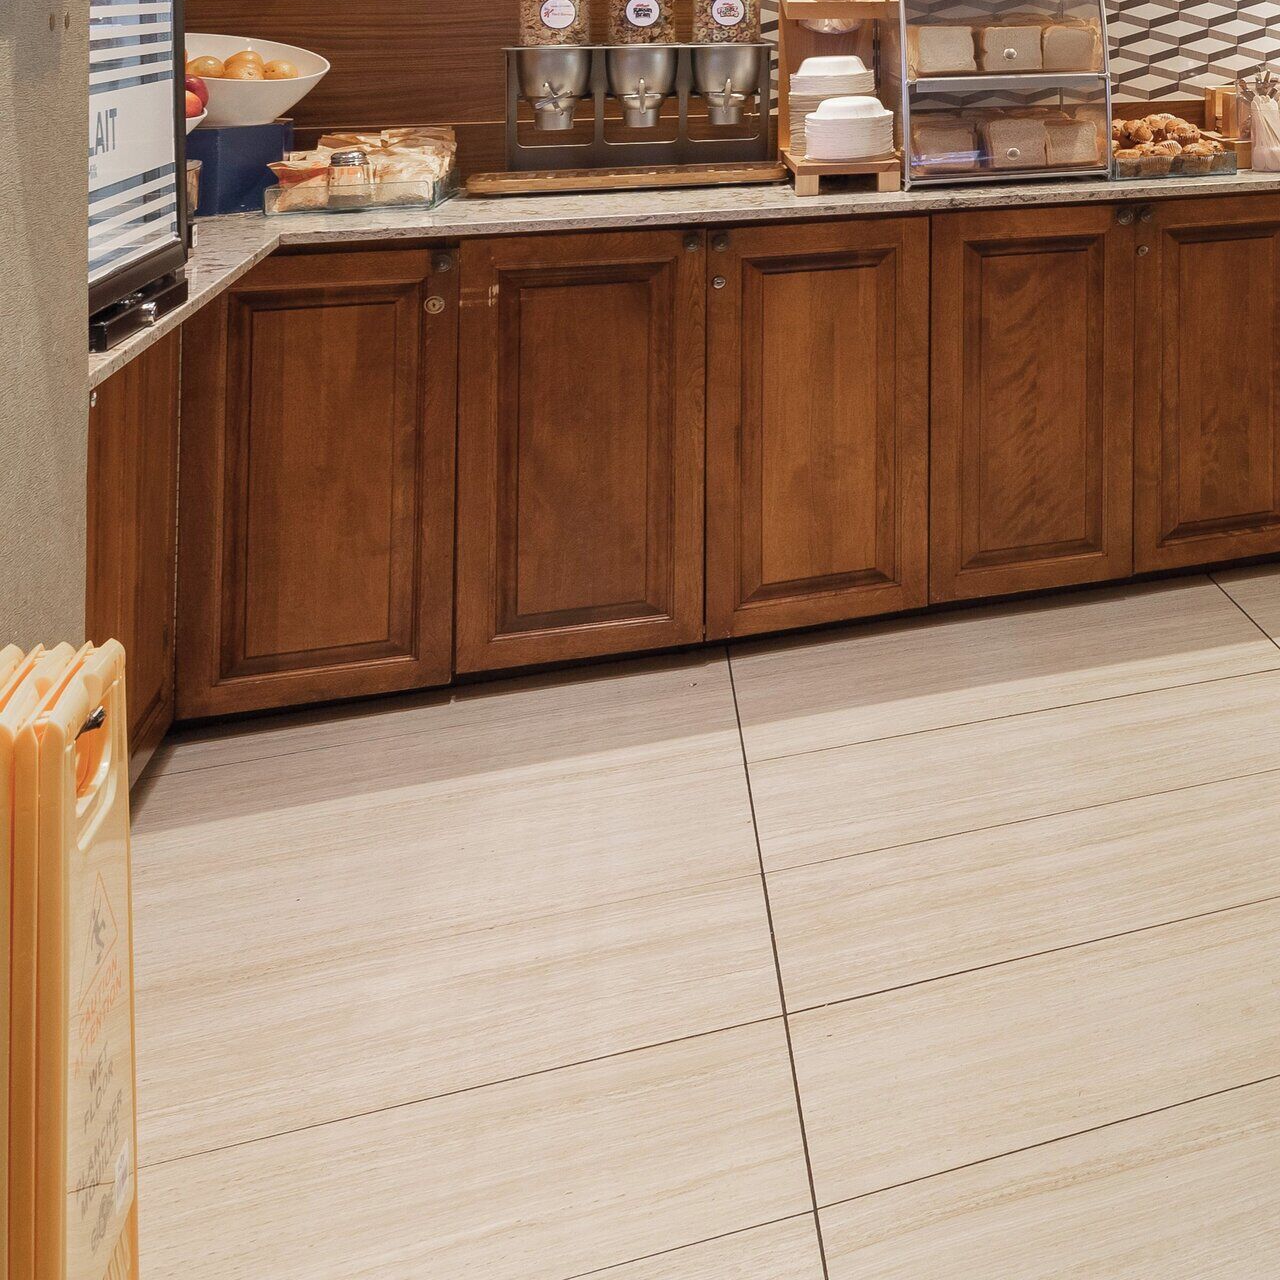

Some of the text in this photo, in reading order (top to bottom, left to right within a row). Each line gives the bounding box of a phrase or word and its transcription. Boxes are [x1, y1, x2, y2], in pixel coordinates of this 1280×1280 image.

[84, 1059, 114, 1134] FLOOR
[89, 1040, 108, 1092] WET
[76, 1088, 122, 1204] PLANCHER
